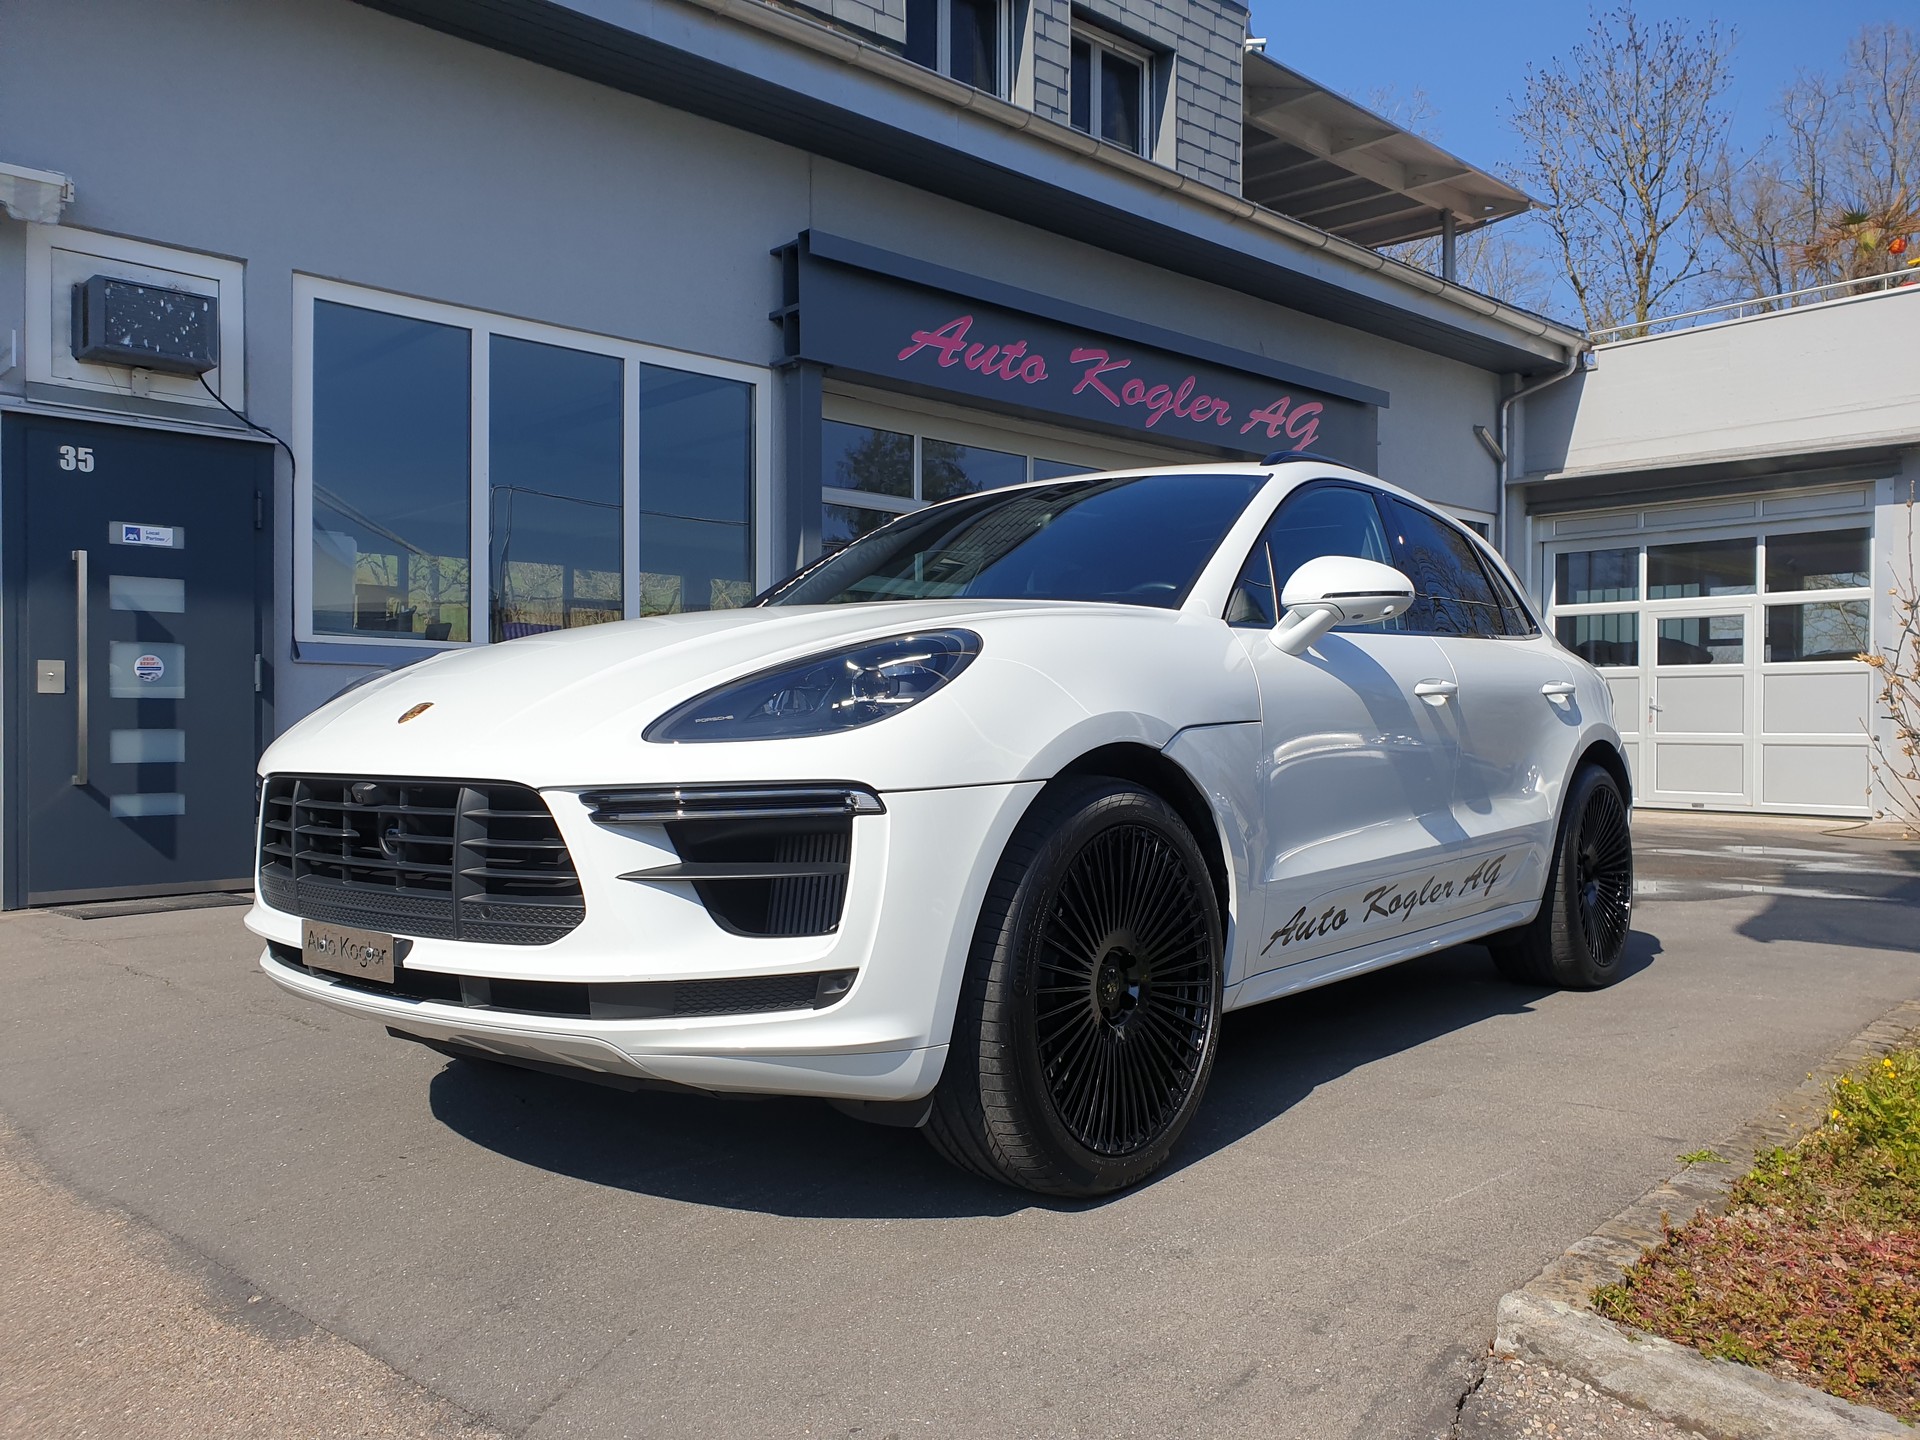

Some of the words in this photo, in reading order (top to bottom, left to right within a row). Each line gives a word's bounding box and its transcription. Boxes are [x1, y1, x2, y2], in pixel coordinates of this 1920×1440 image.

[898, 315, 1049, 383] Auto
[1070, 347, 1232, 428] Kogler
[1239, 396, 1325, 451] AG
[60, 445, 95, 473] 35
[695, 715, 734, 723] PORSCHE
[1260, 906, 1348, 956] Auto
[1362, 875, 1454, 923] Kogler
[1458, 854, 1506, 897] AG
[307, 930, 336, 956] Auto
